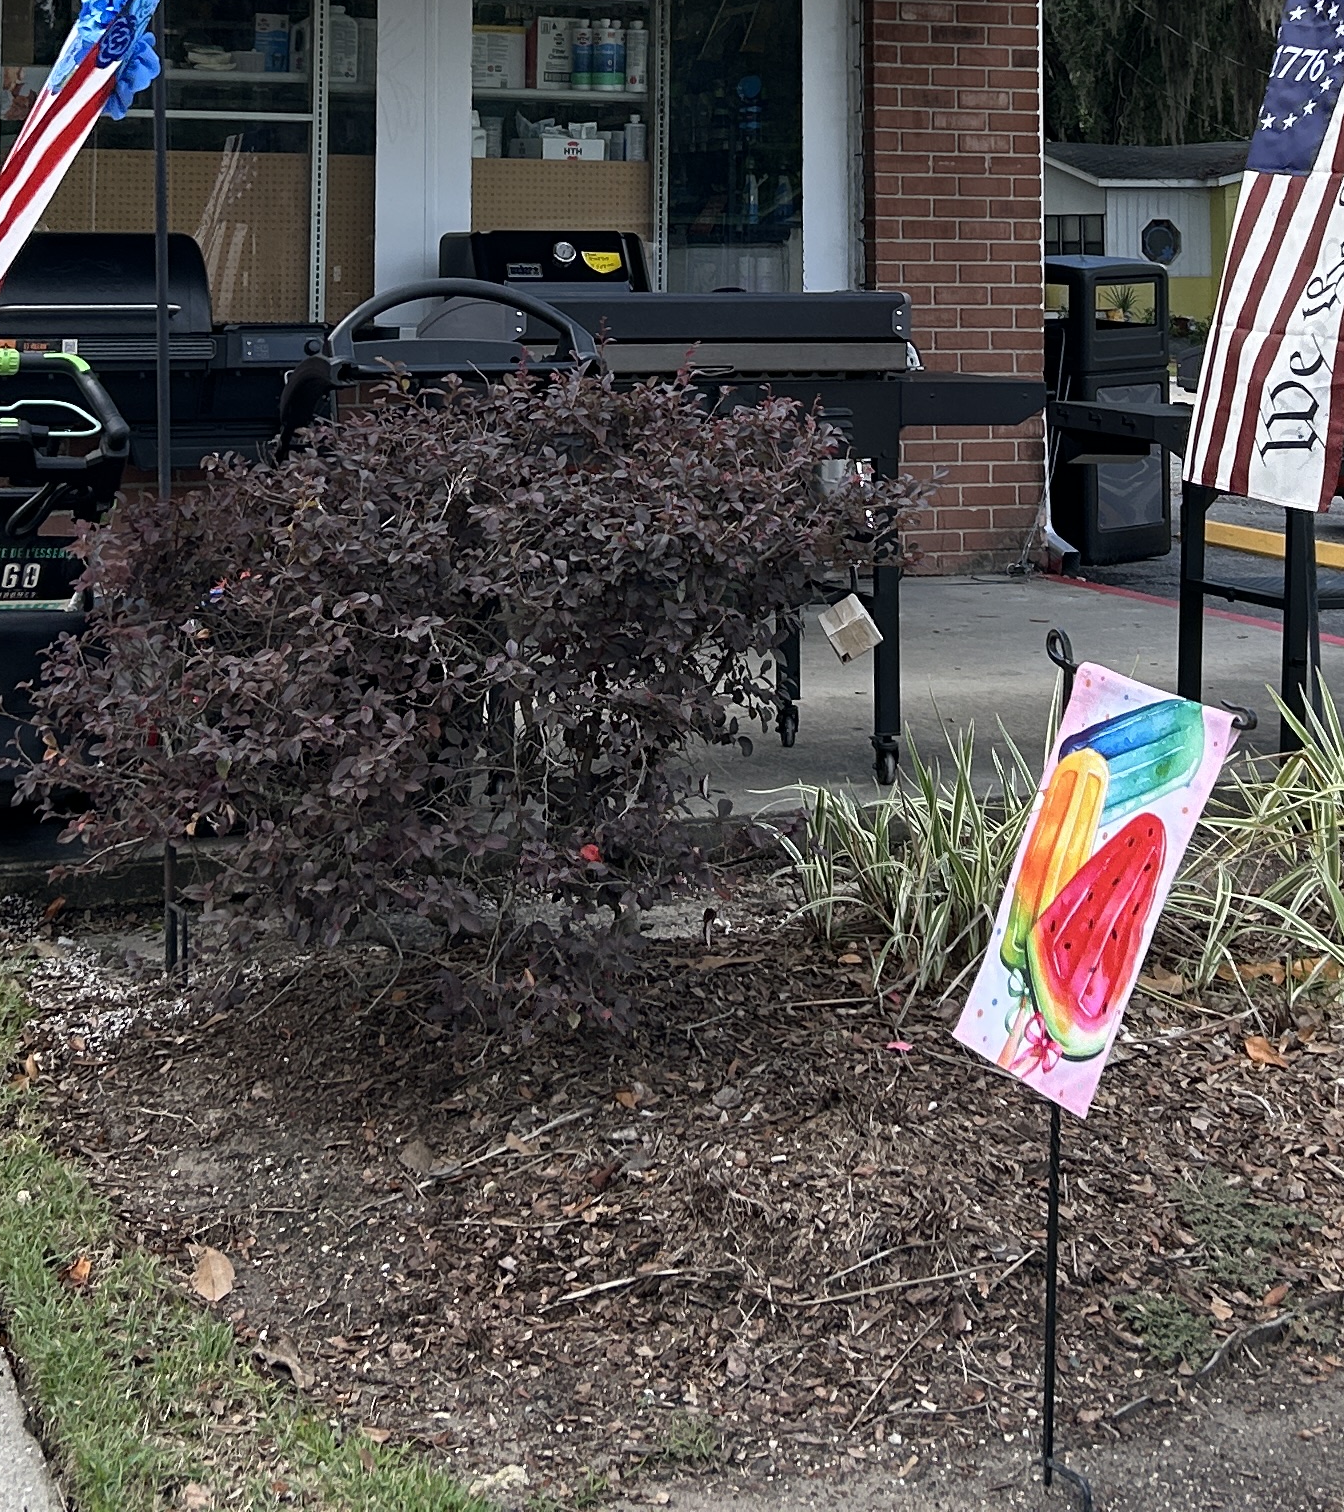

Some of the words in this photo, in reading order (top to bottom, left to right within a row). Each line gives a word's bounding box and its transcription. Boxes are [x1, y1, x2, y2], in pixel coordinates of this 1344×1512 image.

[1268, 44, 1329, 82] 1776
[563, 147, 583, 156] HTH
[1256, 334, 1335, 468] We
[10, 547, 23, 558] DE
